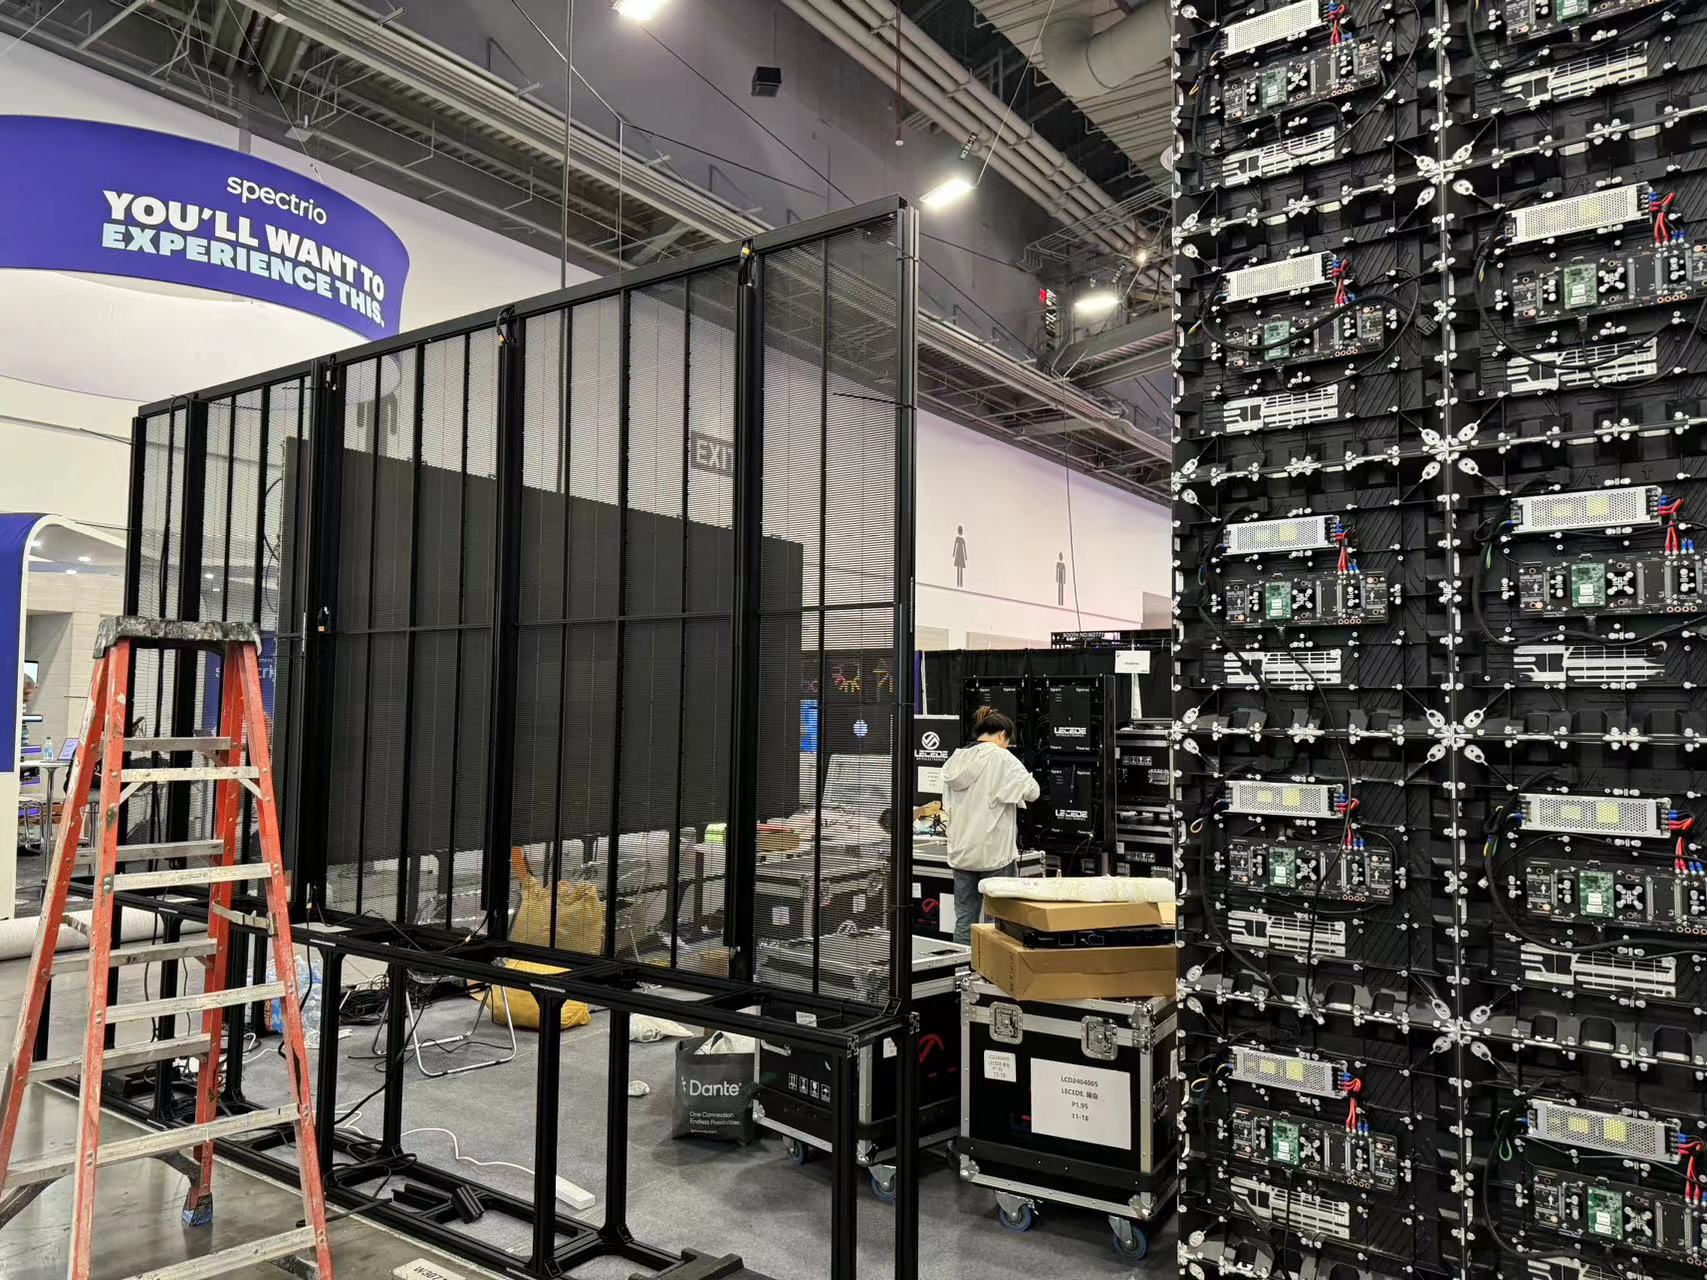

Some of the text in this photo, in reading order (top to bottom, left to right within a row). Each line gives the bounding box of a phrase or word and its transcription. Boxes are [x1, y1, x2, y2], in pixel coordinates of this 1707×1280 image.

[226, 176, 327, 225] spectrio
[265, 223, 359, 280] WANT
[361, 265, 386, 302] TO
[101, 222, 386, 328] EXPERIENCE THIS.
[1054, 727, 1086, 735] LECEDE
[689, 1080, 740, 1096] Dante
[1072, 1101, 1088, 1109] P1.95
[413, 1266, 448, 1280] W307
